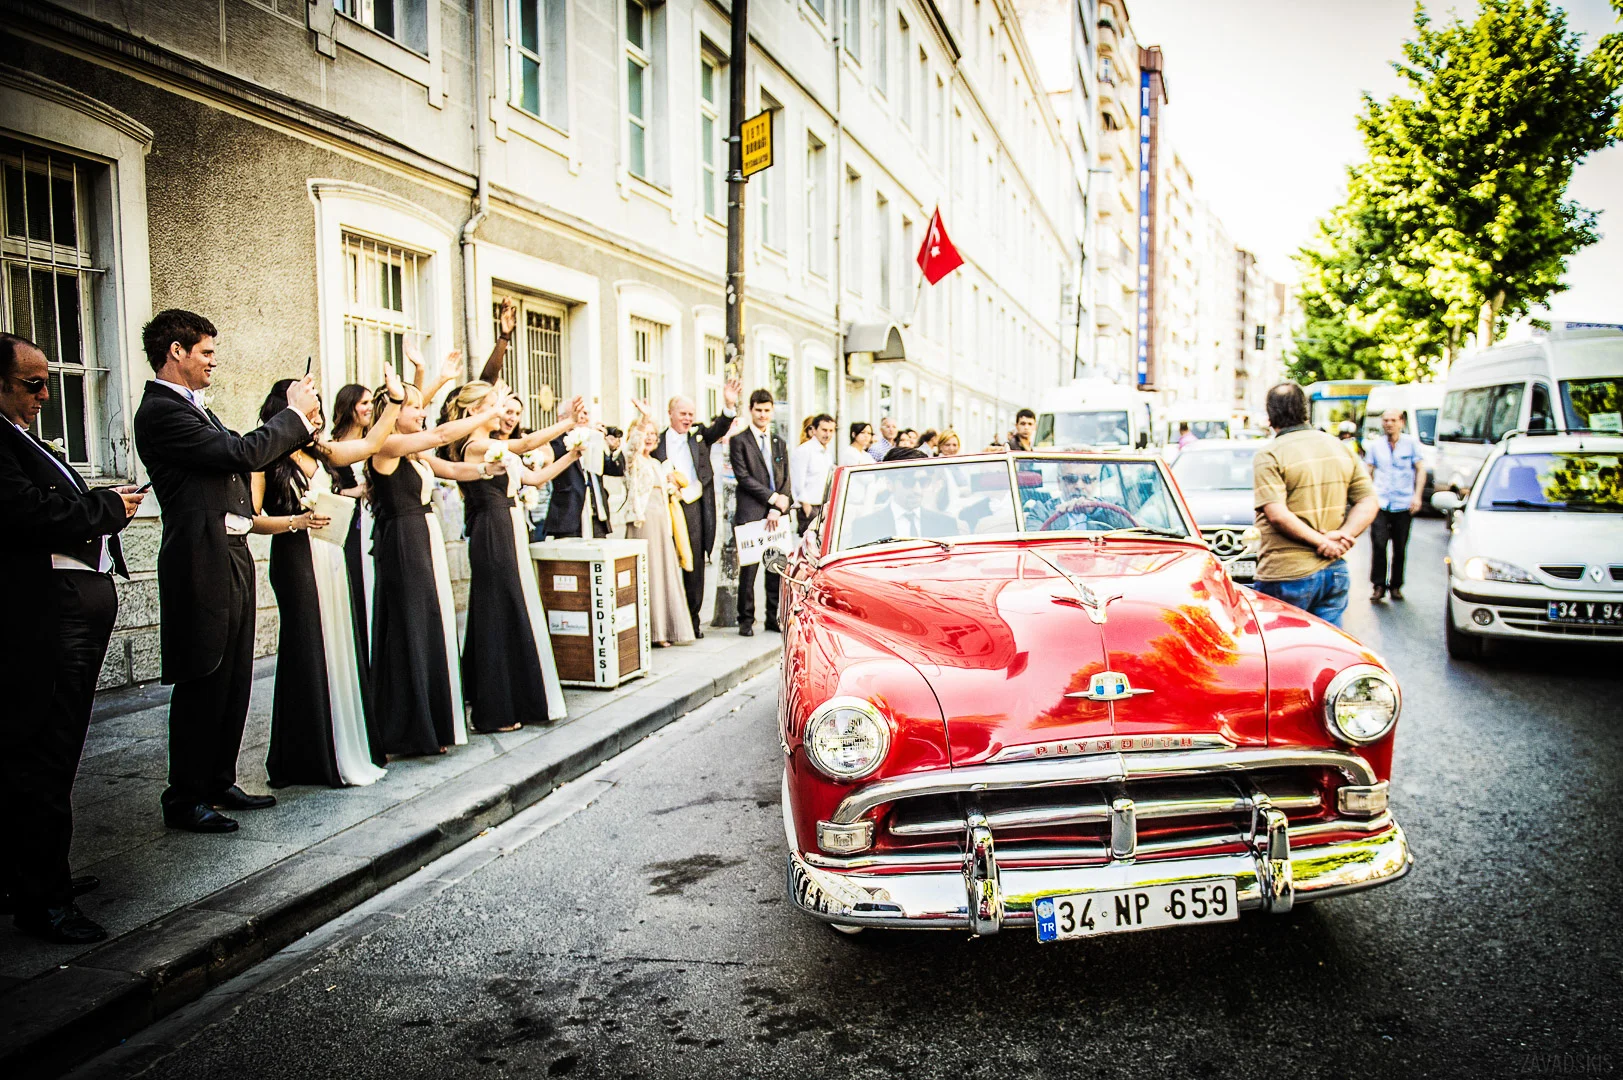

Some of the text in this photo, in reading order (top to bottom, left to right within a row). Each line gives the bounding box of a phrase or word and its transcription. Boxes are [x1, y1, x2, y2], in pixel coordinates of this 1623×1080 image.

[758, 537, 764, 546] &
[1558, 601, 1577, 618] 34
[1035, 737, 1193, 756] PLYMOUTH
[1058, 885, 1228, 933] 34 NP 659
[1042, 922, 1055, 933] TR
